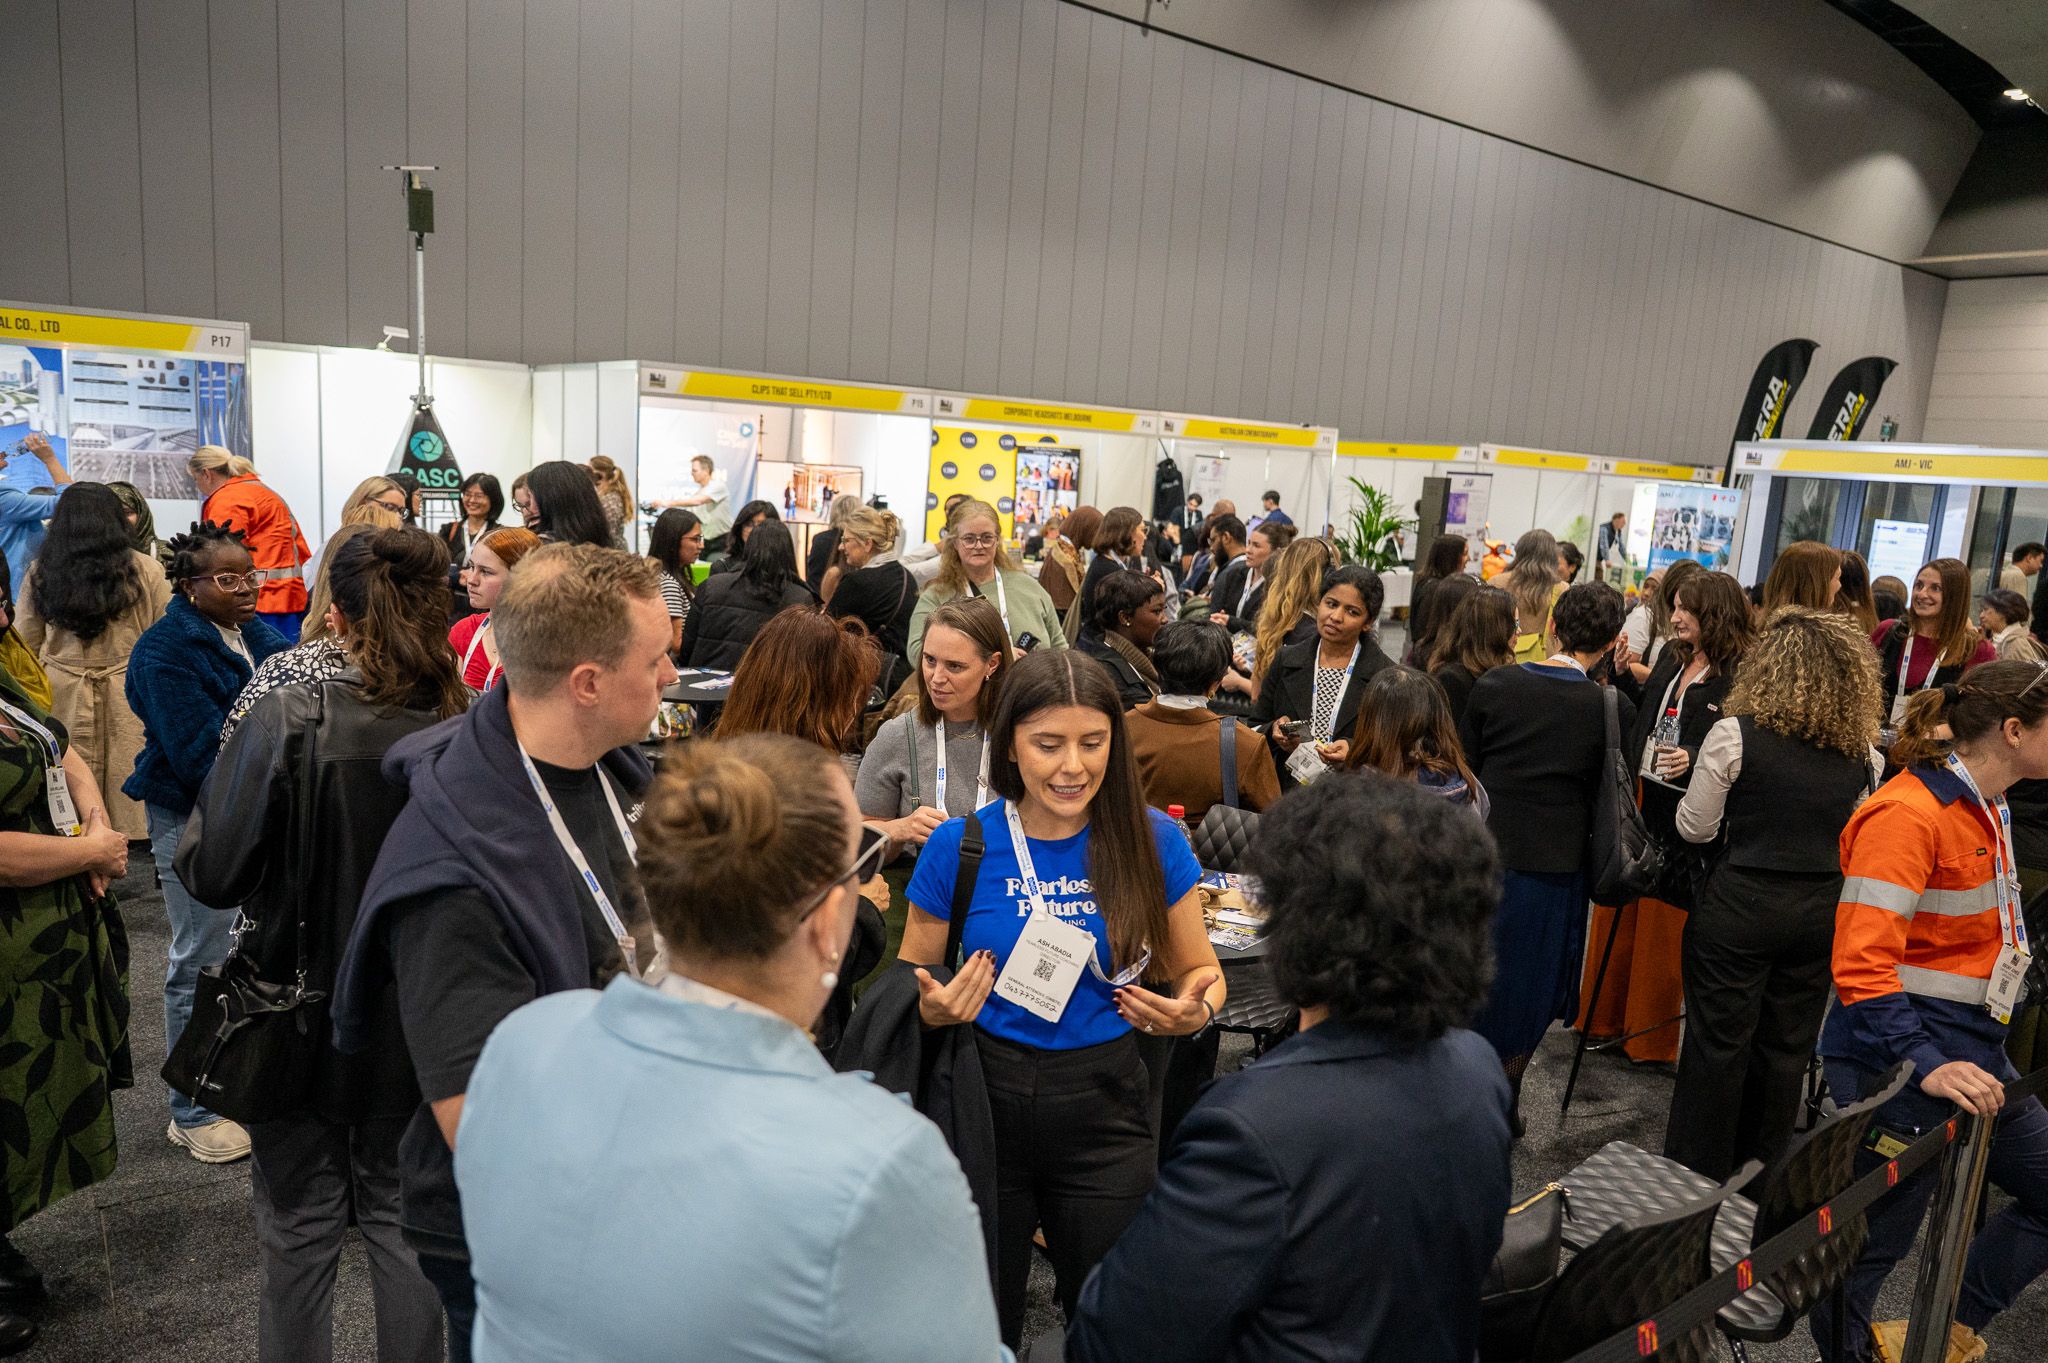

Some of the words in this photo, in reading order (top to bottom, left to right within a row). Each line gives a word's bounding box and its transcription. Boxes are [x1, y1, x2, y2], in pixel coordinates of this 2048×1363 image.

[15, 317, 37, 333] CO.,
[40, 320, 60, 333] LTD
[211, 335, 231, 347] P17
[752, 384, 770, 395] CLIPS
[789, 387, 804, 398] SELL
[1919, 459, 1933, 470] VIC
[1037, 938, 1050, 948] ASH
[1050, 944, 1072, 959] ABADIA
